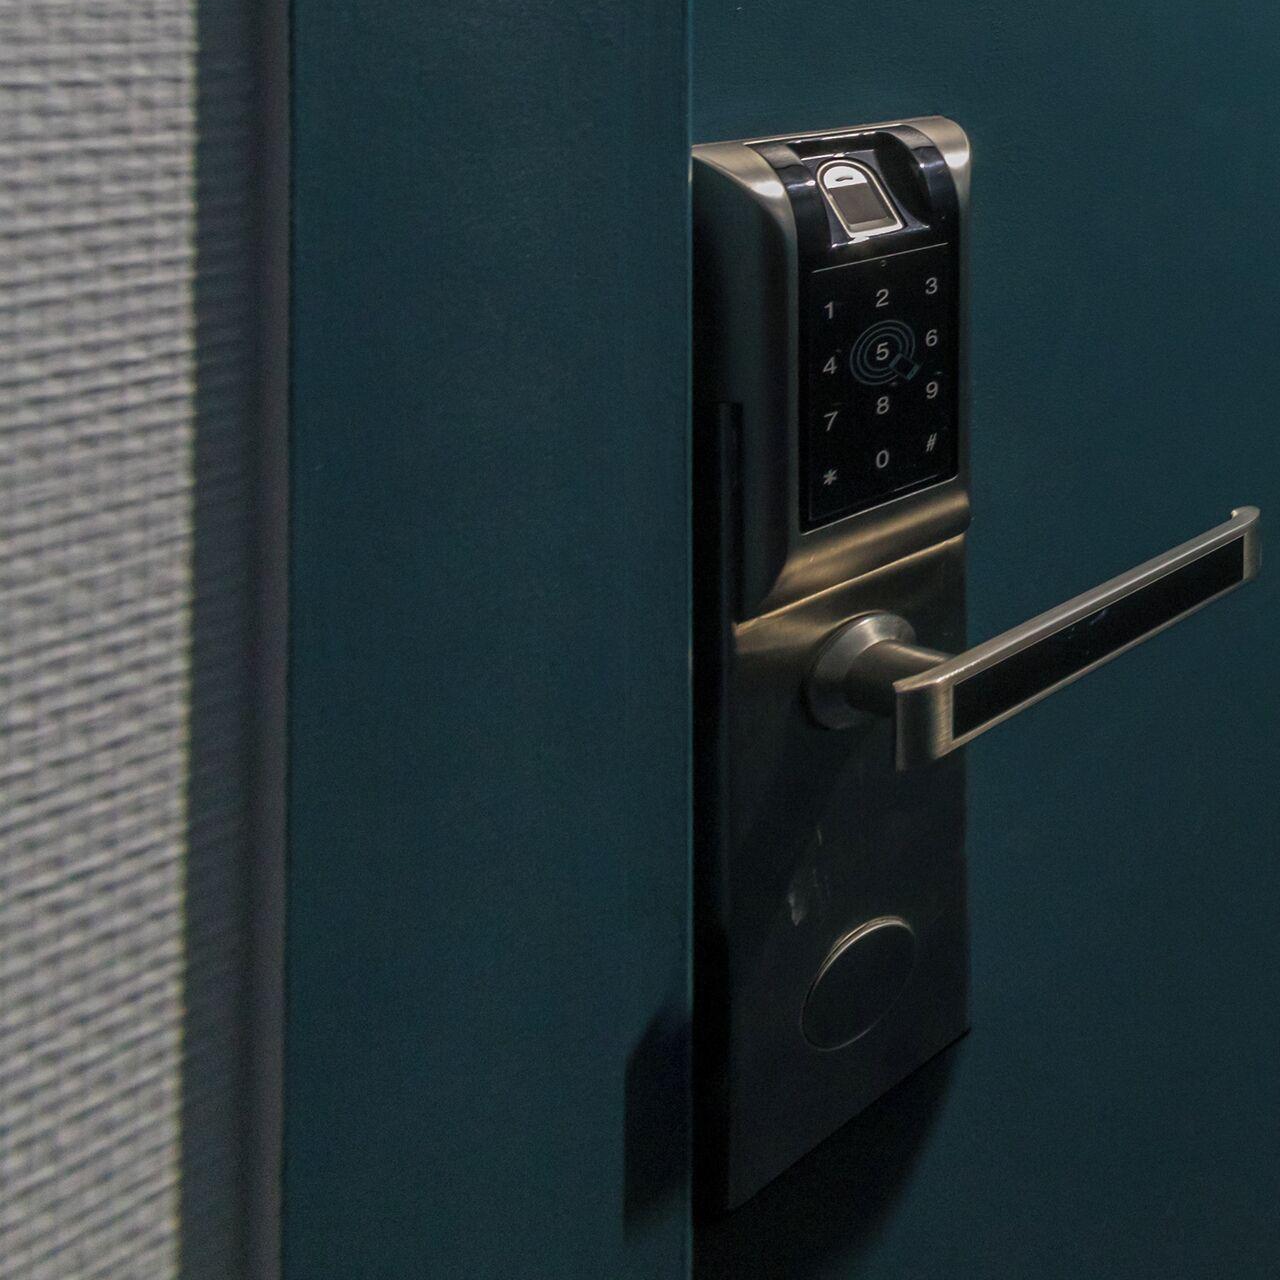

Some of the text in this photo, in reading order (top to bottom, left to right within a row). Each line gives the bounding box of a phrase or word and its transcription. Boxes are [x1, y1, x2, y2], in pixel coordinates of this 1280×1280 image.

[823, 276, 938, 320] 1 2 3
[822, 328, 938, 375] 4 5 6
[823, 380, 939, 432] 7 8 9
[875, 449, 890, 469] 0
